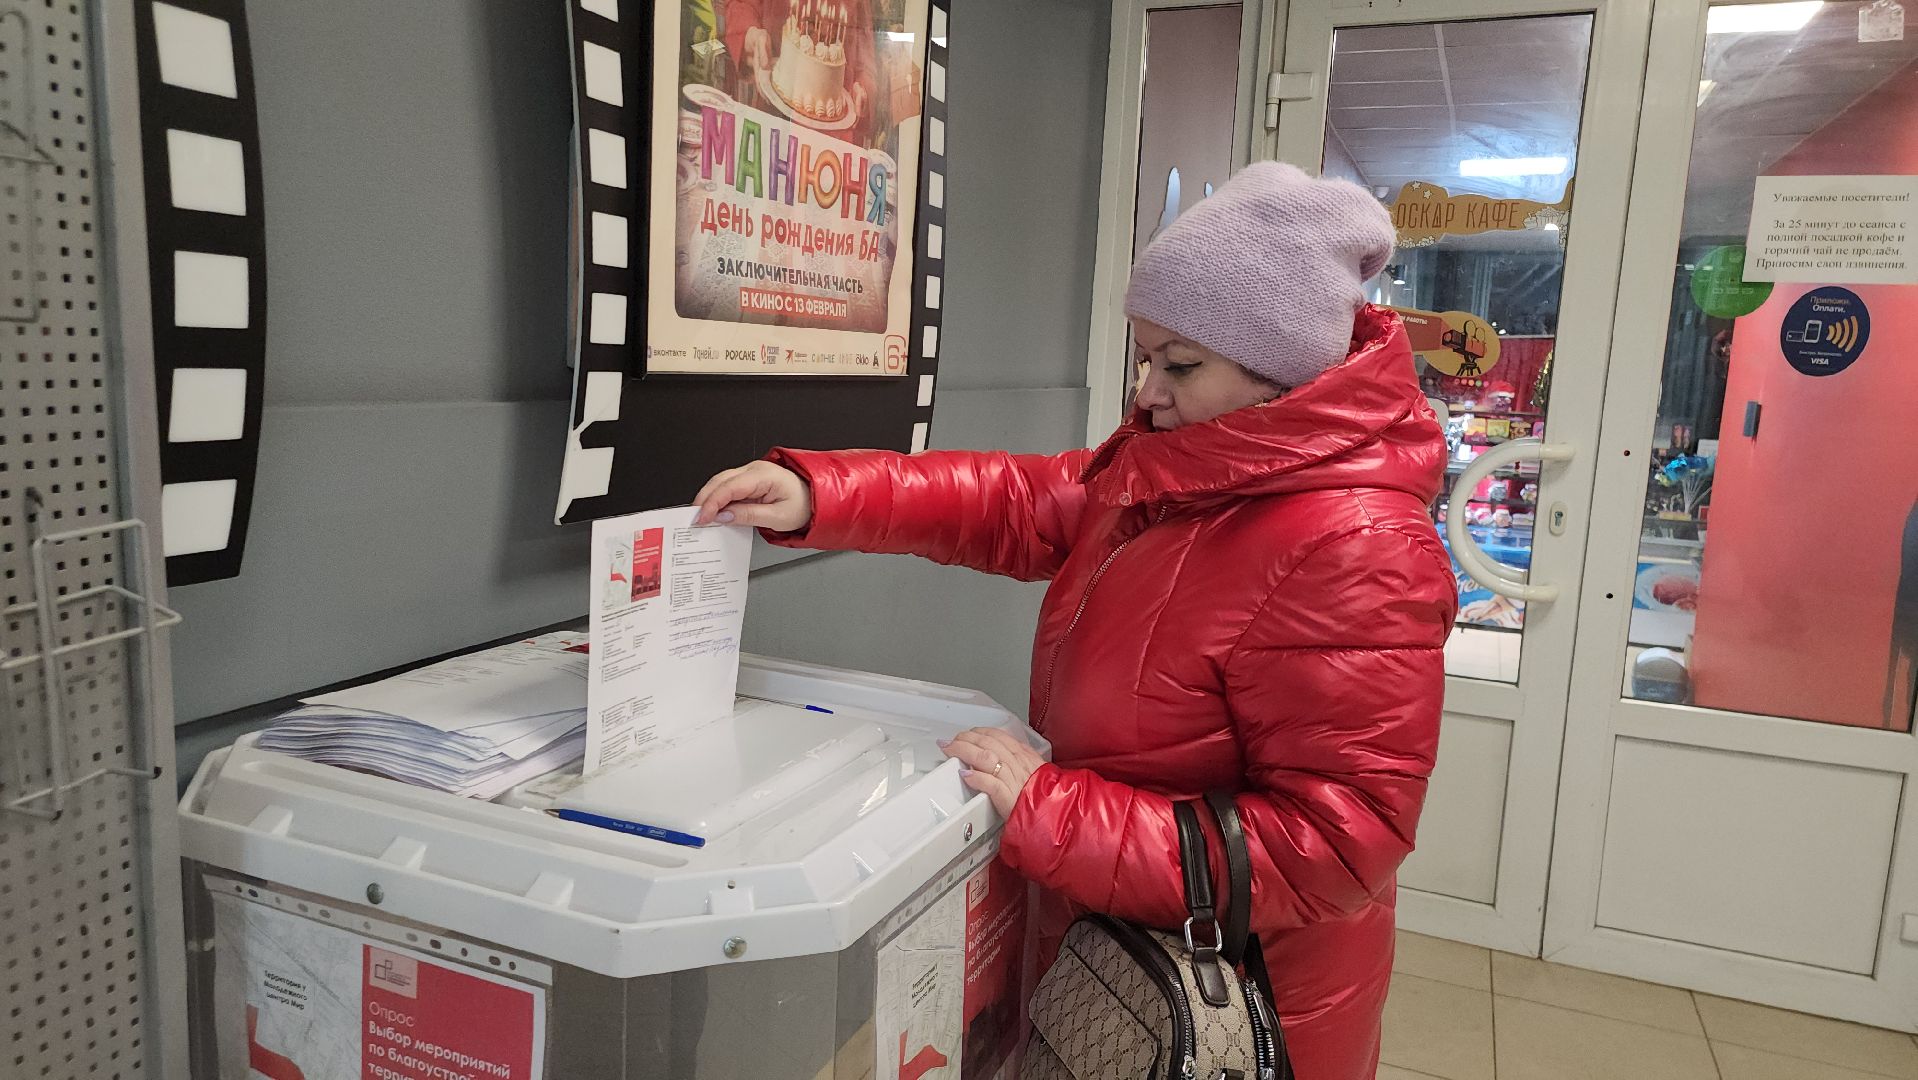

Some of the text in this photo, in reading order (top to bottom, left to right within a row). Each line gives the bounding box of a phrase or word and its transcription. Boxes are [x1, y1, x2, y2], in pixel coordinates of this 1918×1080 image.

[701, 106, 887, 226] МАНЮНЯ
[1773, 192, 1910, 202] Уважаемые посетители!
[1396, 200, 1520, 229] ОСКАР КАФЕ
[761, 213, 854, 258] рождения
[1773, 220, 1906, 231] За 25 минут до сеанса с
[1767, 233, 1807, 242] полной
[1811, 233, 1863, 242] посадкой
[1866, 233, 1894, 244] кофе
[1765, 246, 1810, 257] горячий
[1813, 246, 1832, 255] чай
[1756, 259, 1813, 270] Приносим
[717, 257, 864, 294] ЗАКЛЮЧИТЕЛЬНАЯ ЧАСТЬ
[741, 290, 847, 317] В КИНО С 13 ФЕВРАЛЯ
[1812, 304, 1846, 312] Оплати.
[888, 344, 908, 370] 6+
[290, 1000, 304, 1010] Мир
[368, 1001, 415, 1027] Опрос
[369, 1020, 511, 1079] Выбор мероприятий
[369, 1043, 385, 1057] по
